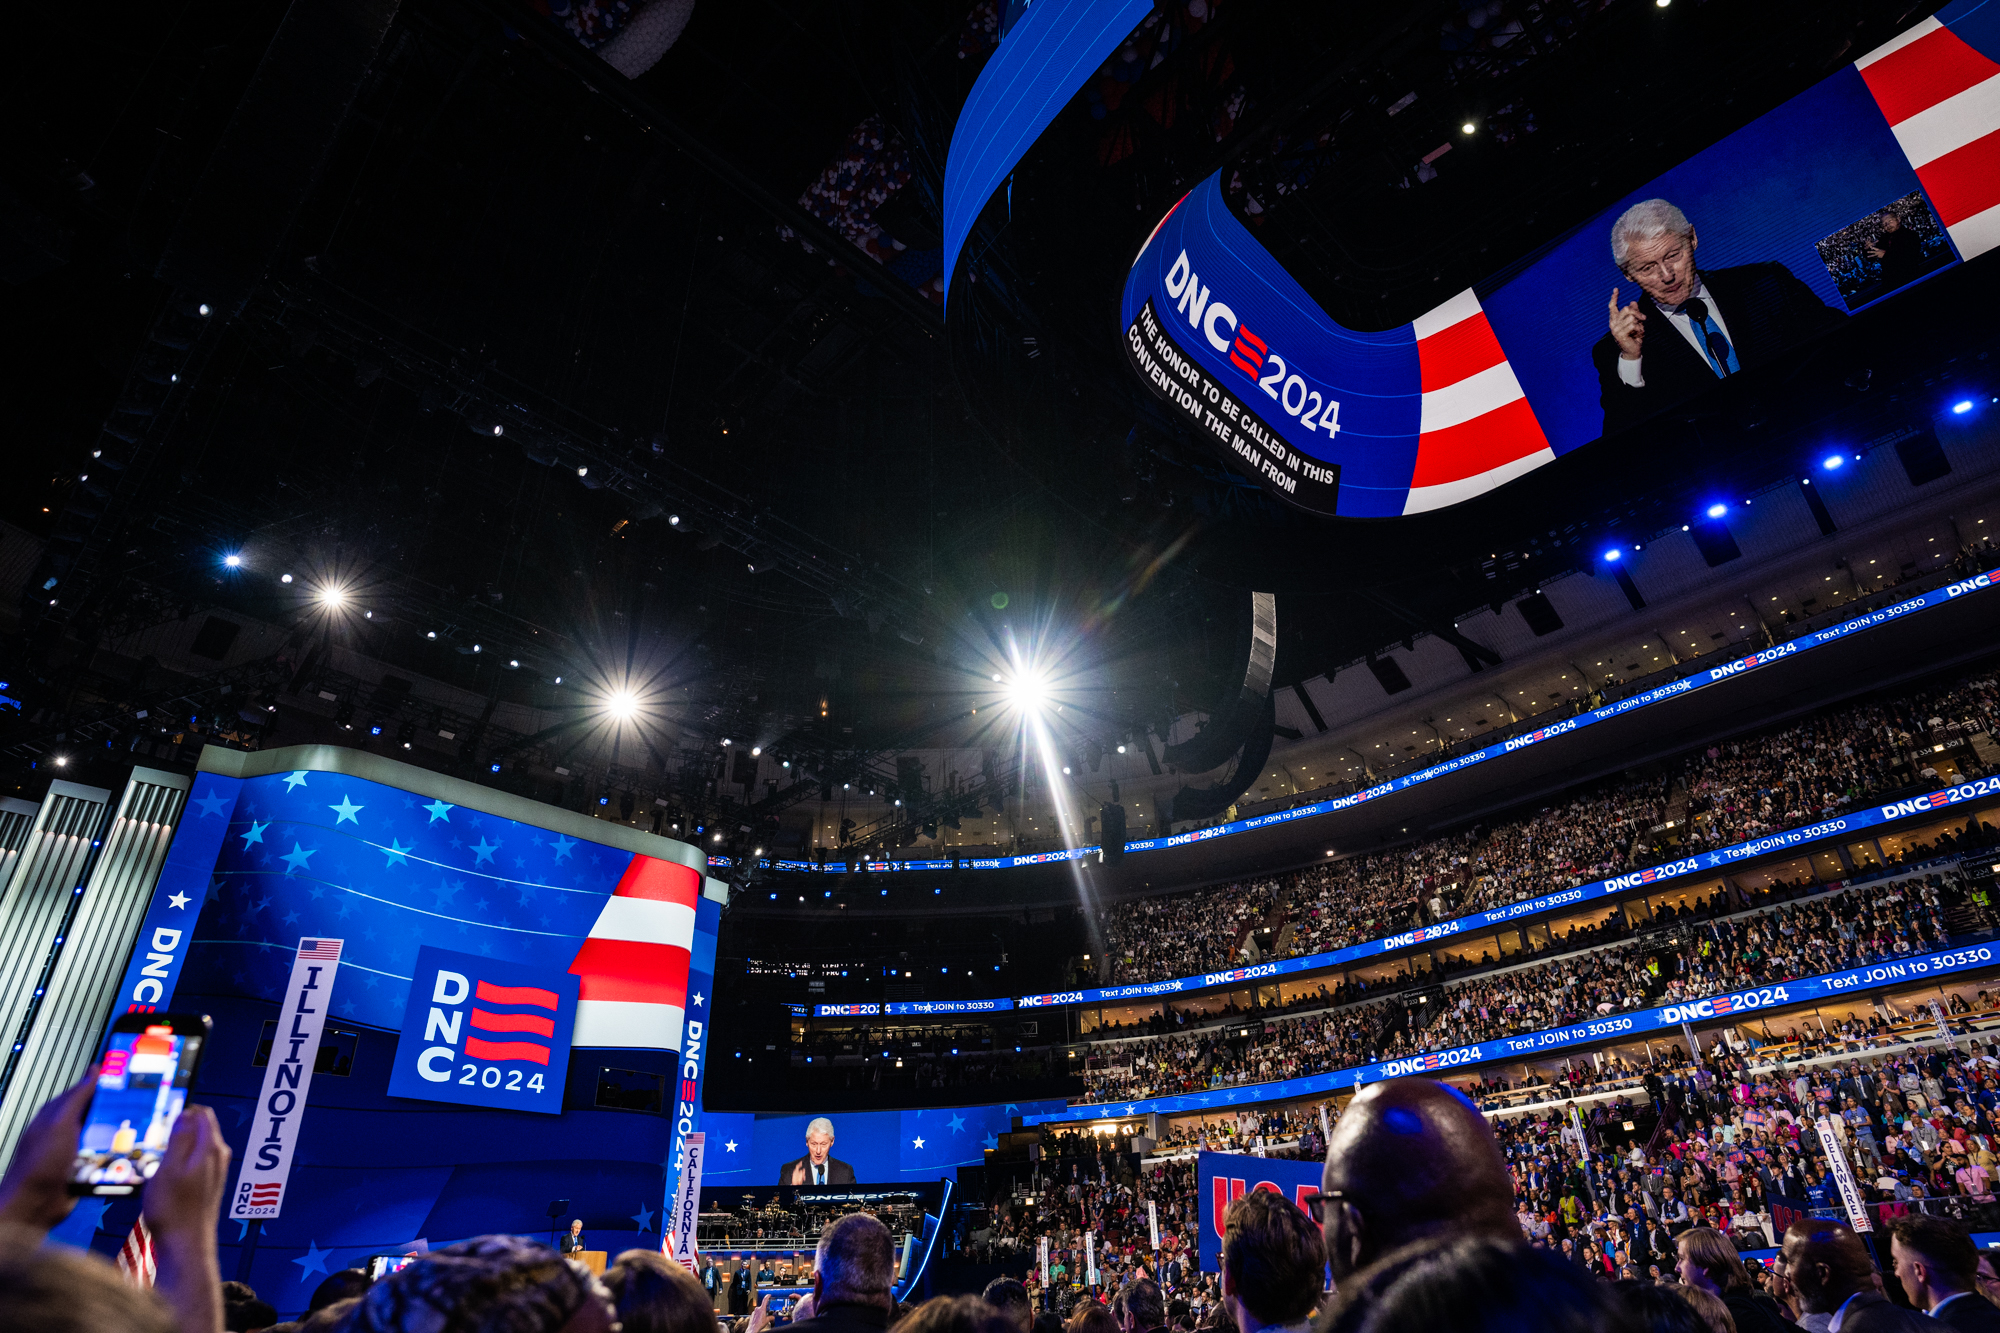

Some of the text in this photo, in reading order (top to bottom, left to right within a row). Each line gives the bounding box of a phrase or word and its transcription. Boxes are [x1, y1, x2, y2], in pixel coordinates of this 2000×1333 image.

[1165, 249, 1340, 439] DNC 2024
[1129, 324, 1297, 494] CONVENTION THE MAN FROM
[1141, 303, 1333, 484] THE HONOR TO BE CALLED IN THIS
[1947, 575, 1990, 597] DNC
[1815, 599, 1925, 640] Text JOIN to 30330
[1710, 643, 1796, 679] DNC 2024
[1594, 682, 1684, 718] Text JOIN to 30330
[1505, 720, 1576, 751] DNC 2024
[1411, 752, 1485, 782] Text JOIN to 30330
[1920, 748, 1932, 756] 334
[1333, 783, 1393, 809] DNC 2024
[1882, 778, 2000, 819] DNC 2024
[1263, 815, 1281, 823] JOIN
[1283, 812, 1291, 820] to
[1292, 807, 1316, 817] 30330
[1167, 827, 1226, 846] DNC 2024
[1724, 820, 1846, 859] Text JOIN to 30330
[1014, 851, 1072, 865] DNC 2024
[1604, 859, 1698, 892] DNC 2024
[1485, 910, 1505, 921] Text
[1509, 903, 1533, 916] JOIN
[1547, 890, 1581, 905] 30330
[1384, 922, 1459, 949] DNC 2024
[133, 928, 182, 1003] DNC
[1206, 964, 1276, 985] DNC 2024
[1822, 948, 1991, 989] Text JOIN to 30330
[1018, 992, 1083, 1007] DNC 2024
[1121, 987, 1141, 995] JOIN
[1154, 981, 1181, 991] 30330
[822, 1005, 849, 1015] DNC
[913, 1003, 932, 1012] Text
[933, 1003, 954, 1011] JOIN
[1662, 987, 1789, 1023] DNC 2024
[417, 970, 544, 1093] DNC 2024
[1507, 1018, 1632, 1050] Text JOIN to 30330
[684, 1020, 702, 1079] DNC
[1385, 1047, 1482, 1076] DNC 2024
[254, 966, 322, 1170] ILLINOIS
[1746, 1112, 1763, 1122] USA
[1729, 1152, 1743, 1162] USA
[1823, 1133, 1858, 1215] DELAWARE
[235, 1183, 276, 1215] DNC 2024
[679, 1148, 698, 1255] CALIFORNIA
